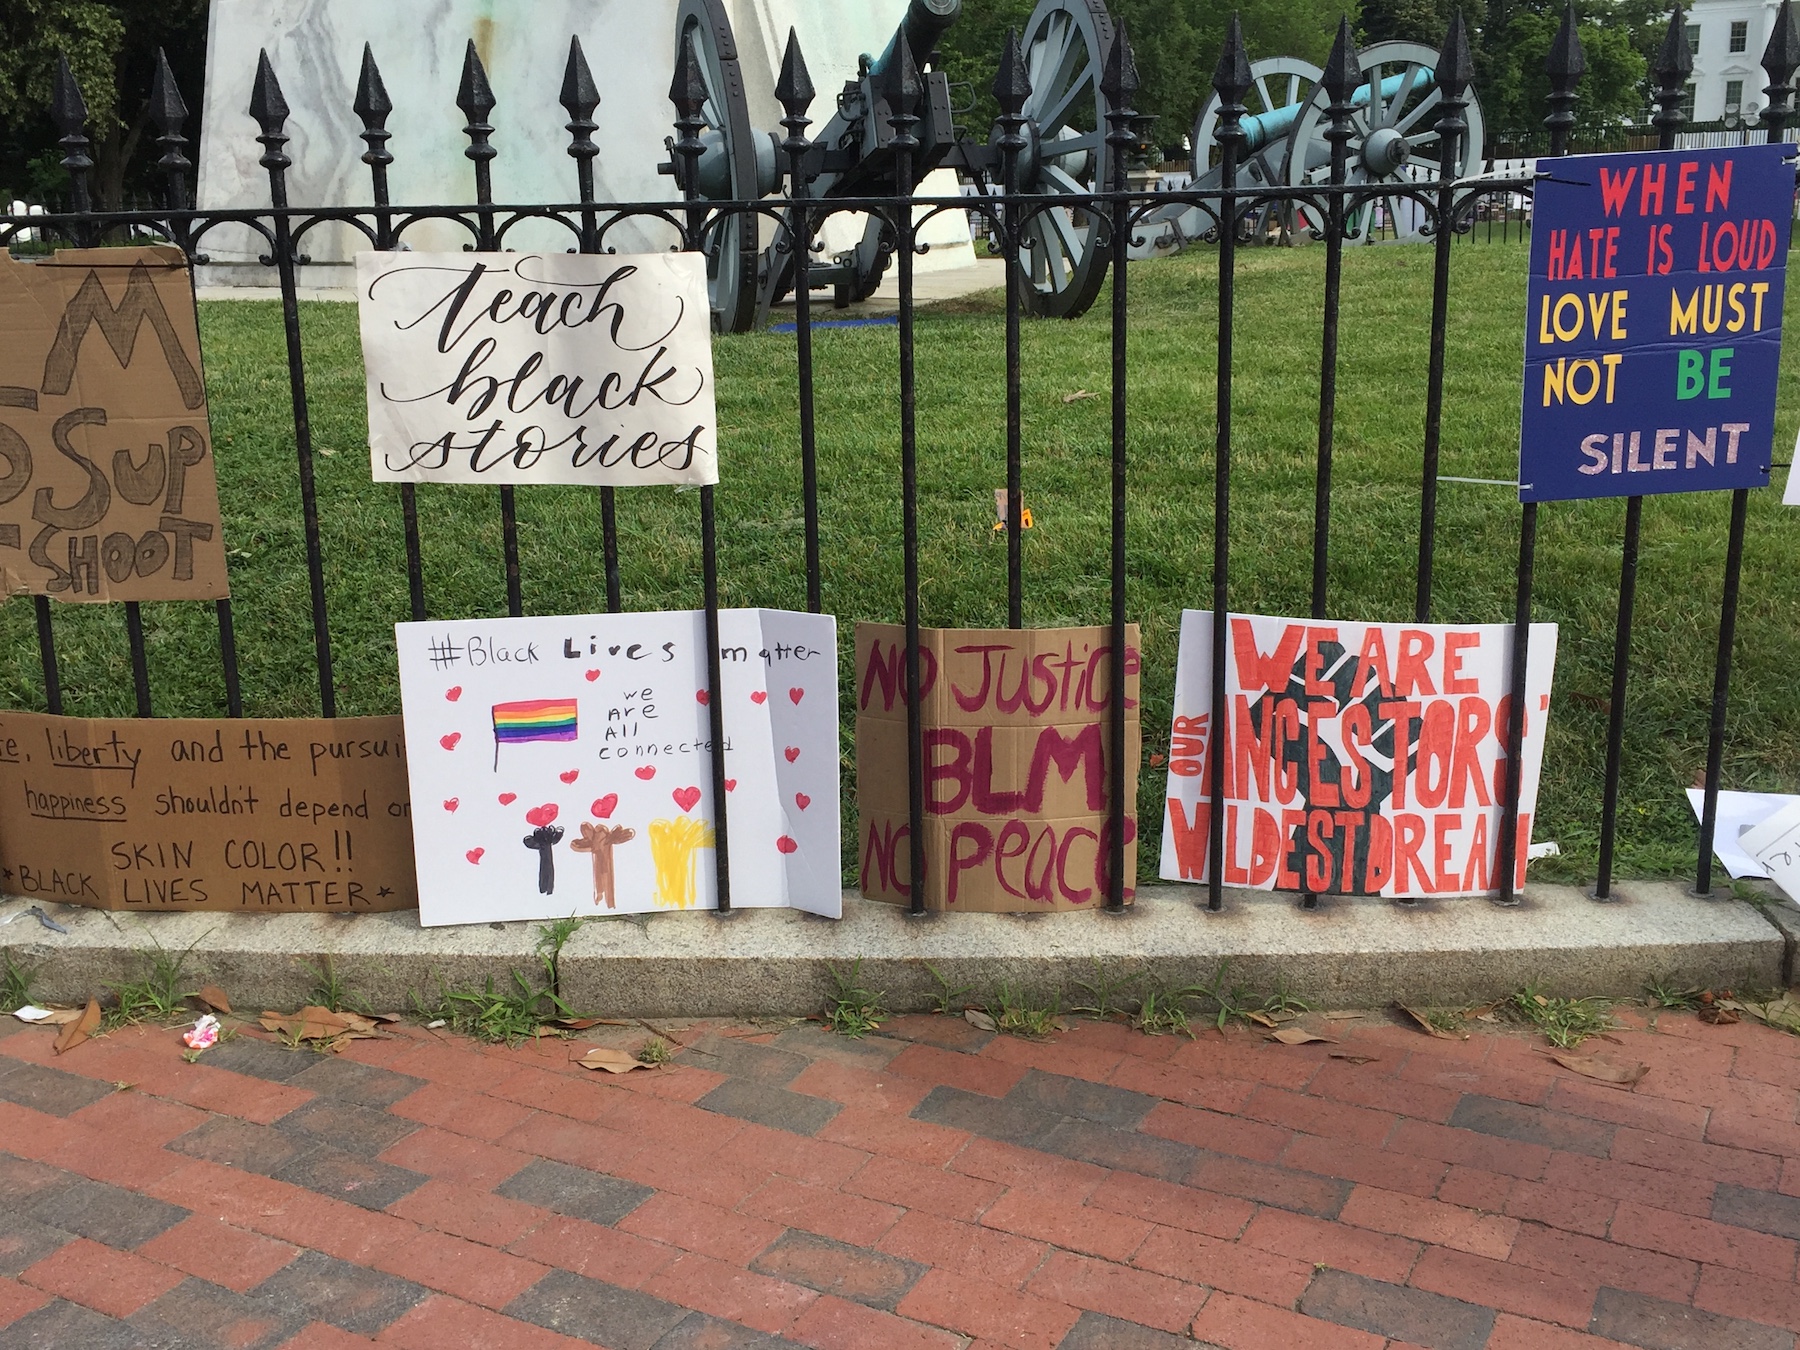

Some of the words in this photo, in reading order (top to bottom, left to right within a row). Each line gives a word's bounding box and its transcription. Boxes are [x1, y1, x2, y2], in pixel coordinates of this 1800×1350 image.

[1600, 160, 1733, 218] WHEN
[1548, 227, 1620, 281] HATE
[1648, 223, 1673, 276] IS
[1699, 219, 1777, 273] LOUD
[368, 256, 684, 353] teach
[1540, 290, 1628, 343] LOVE
[1670, 283, 1770, 335] MUST
[381, 337, 704, 420] black
[1543, 354, 1622, 407] NOT
[1677, 348, 1735, 400] BE
[385, 419, 709, 473] stories
[1577, 423, 1750, 475] SILENT
[29, 517, 213, 594] SHOOT
[564, 635, 677, 662] Lives
[860, 638, 938, 713] NO
[1230, 618, 1339, 697] WE
[1349, 627, 1481, 698] ARE
[45, 727, 141, 788] liberty
[171, 729, 224, 762] and
[240, 729, 291, 761] the
[310, 733, 406, 776] pursui
[922, 722, 1107, 815] BLM
[1168, 713, 1210, 777] OUR
[24, 779, 127, 821] happiness
[279, 788, 369, 826] depend
[110, 839, 193, 870] SKIN
[224, 829, 353, 873] COLOR!!
[1167, 797, 1365, 894] WLDEST
[19, 864, 100, 900] BLACK
[123, 877, 208, 904] LIVES
[242, 880, 371, 906] MATTER
